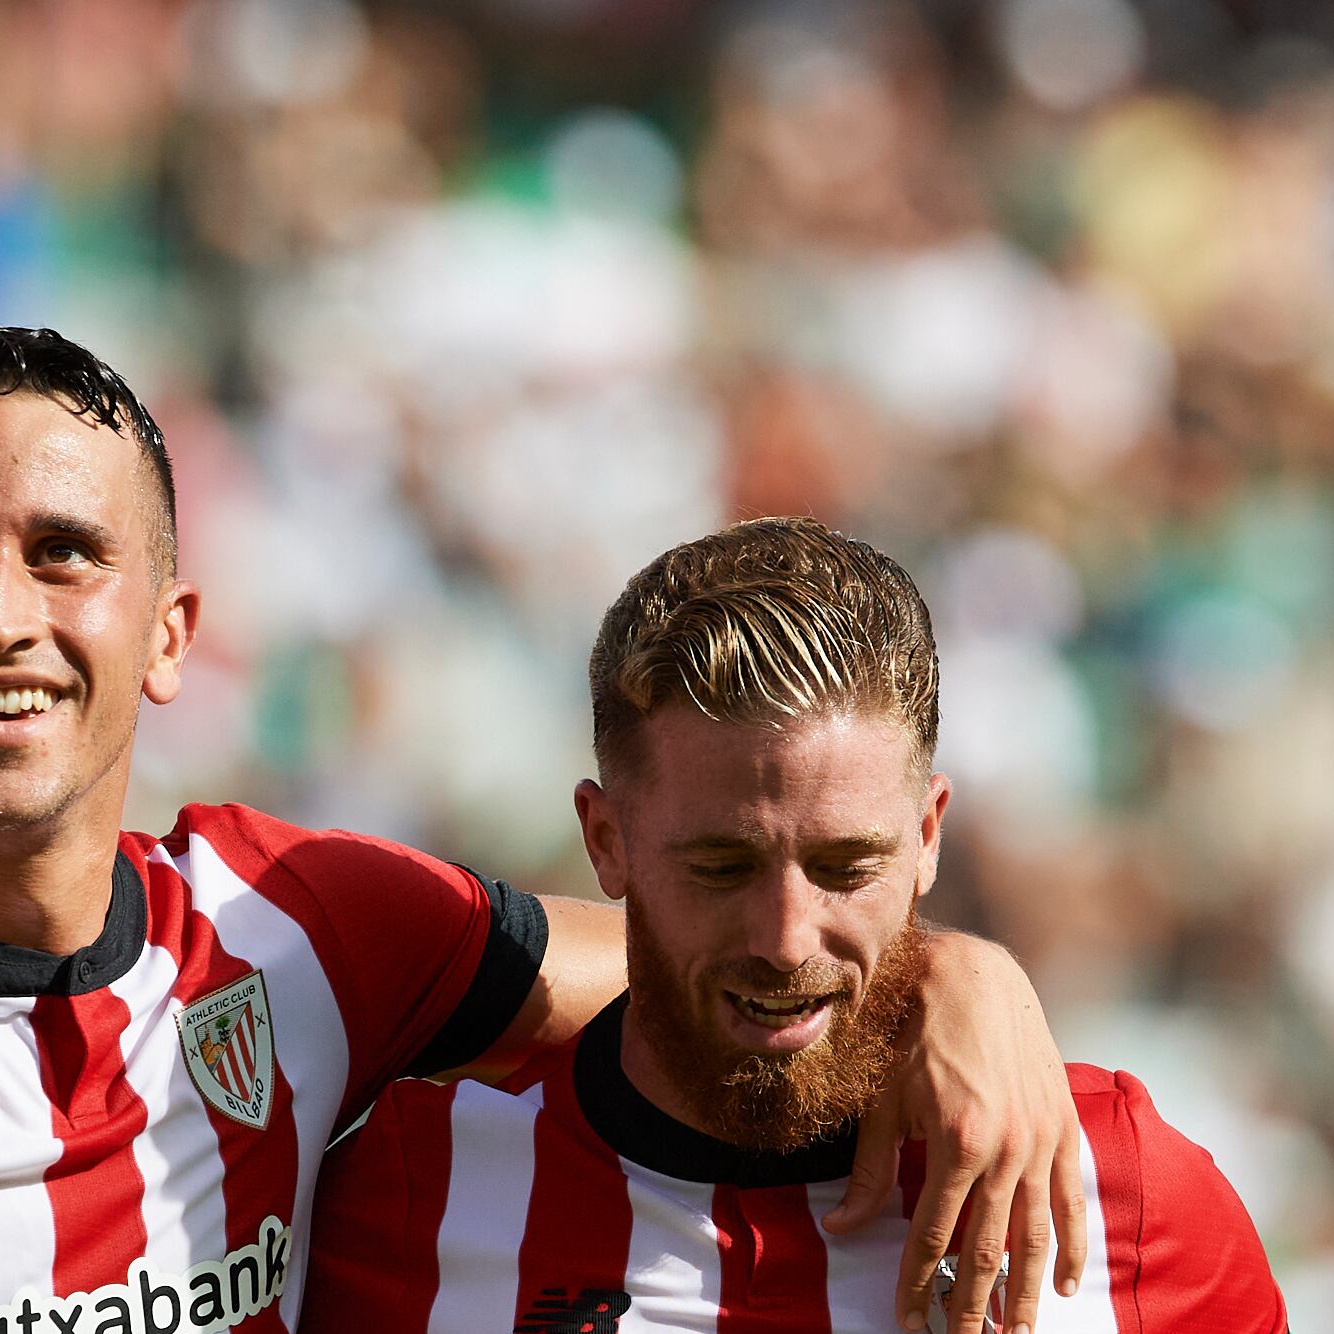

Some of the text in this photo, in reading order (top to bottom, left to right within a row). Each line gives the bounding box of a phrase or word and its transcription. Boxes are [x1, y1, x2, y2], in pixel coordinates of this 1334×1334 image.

[186, 985, 256, 1026] ATHLETIC CLUB
[225, 1078, 264, 1119] BILBAO
